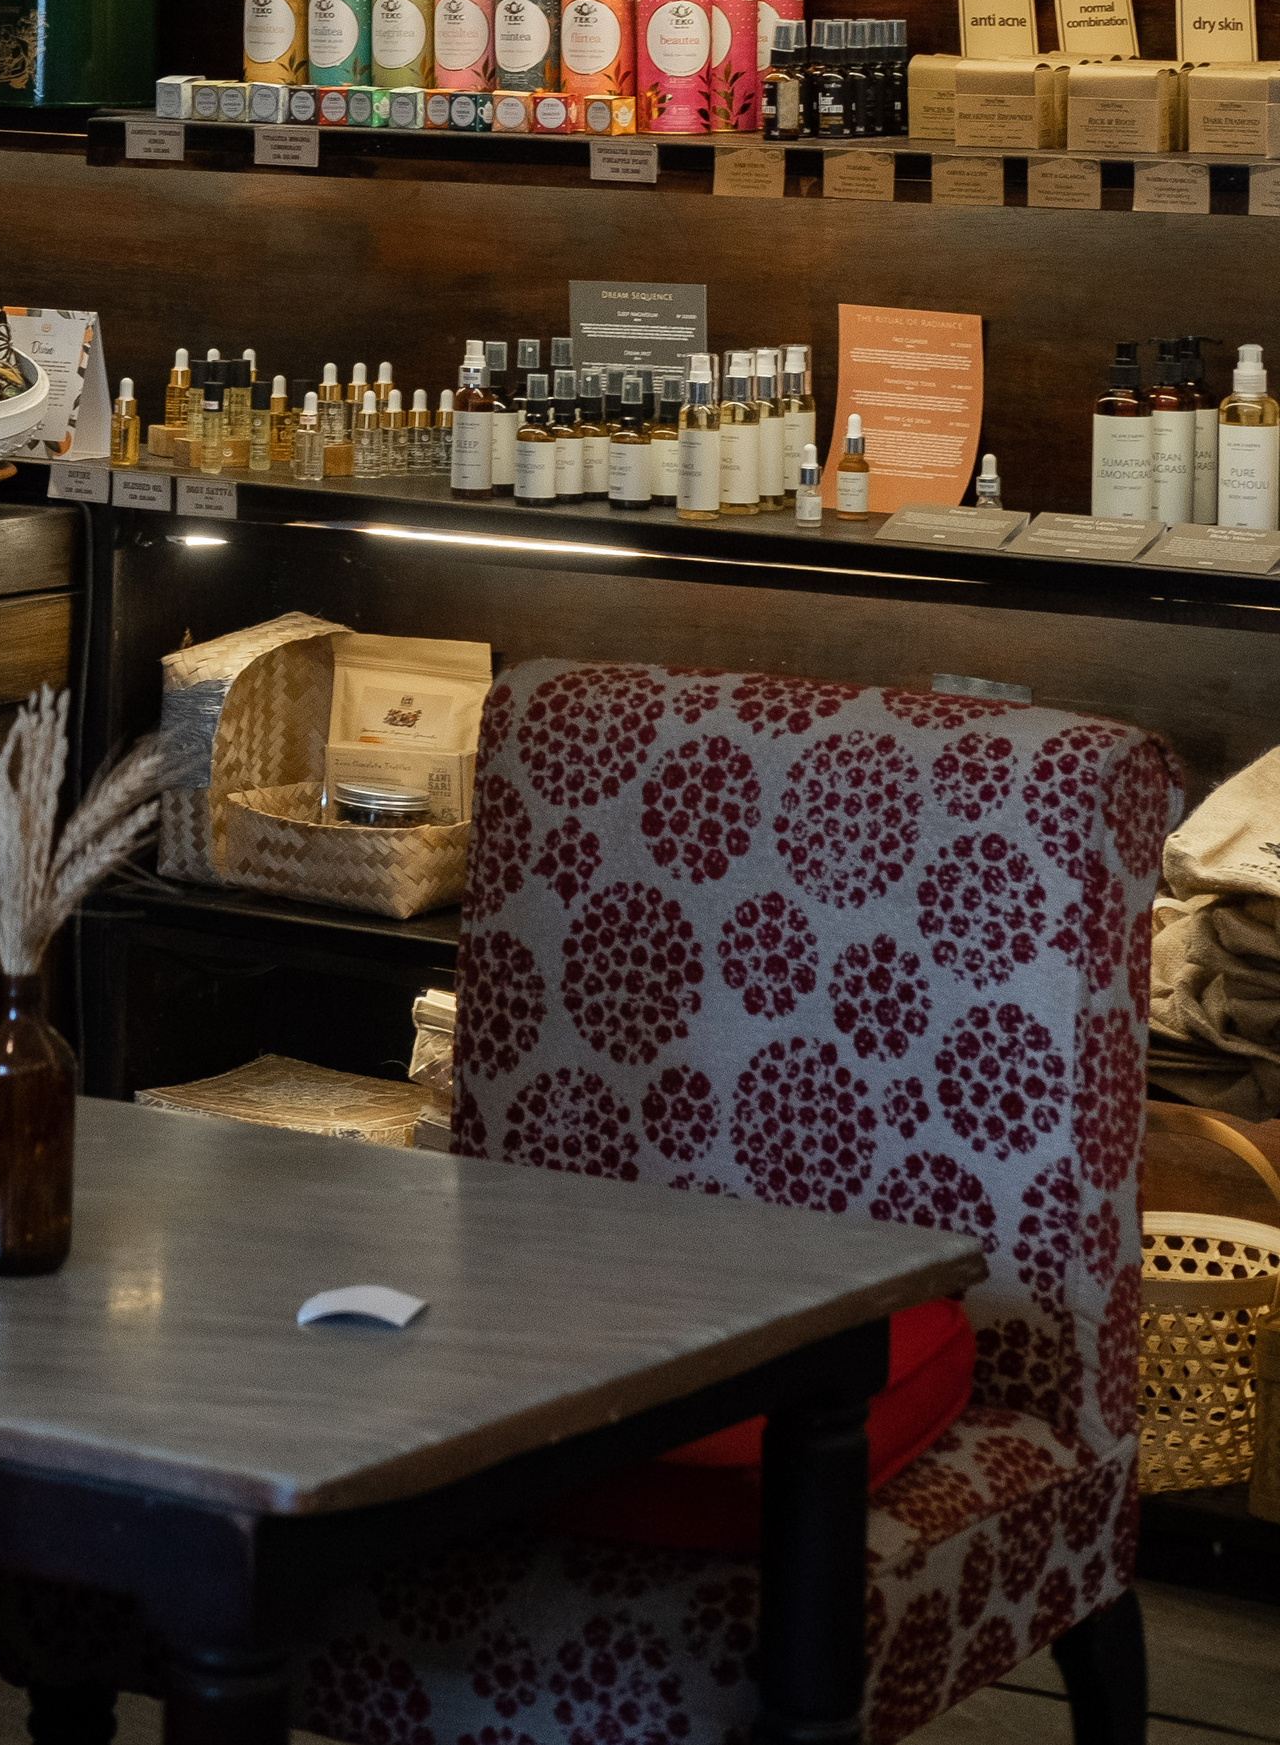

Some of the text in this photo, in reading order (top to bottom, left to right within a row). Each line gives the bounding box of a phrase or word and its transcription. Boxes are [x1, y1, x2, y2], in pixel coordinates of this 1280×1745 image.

[1080, 2, 1114, 14] normal
[970, 14, 1027, 27] anti acne
[1066, 16, 1129, 28] combination
[1192, 16, 1243, 34] dry skin
[660, 35, 700, 45] beautea
[602, 290, 673, 302] DREAM SEQUENCE
[856, 314, 872, 322] THE
[906, 318, 918, 326] OF
[921, 320, 963, 330] RADIANCE
[1230, 468, 1256, 478] PURE
